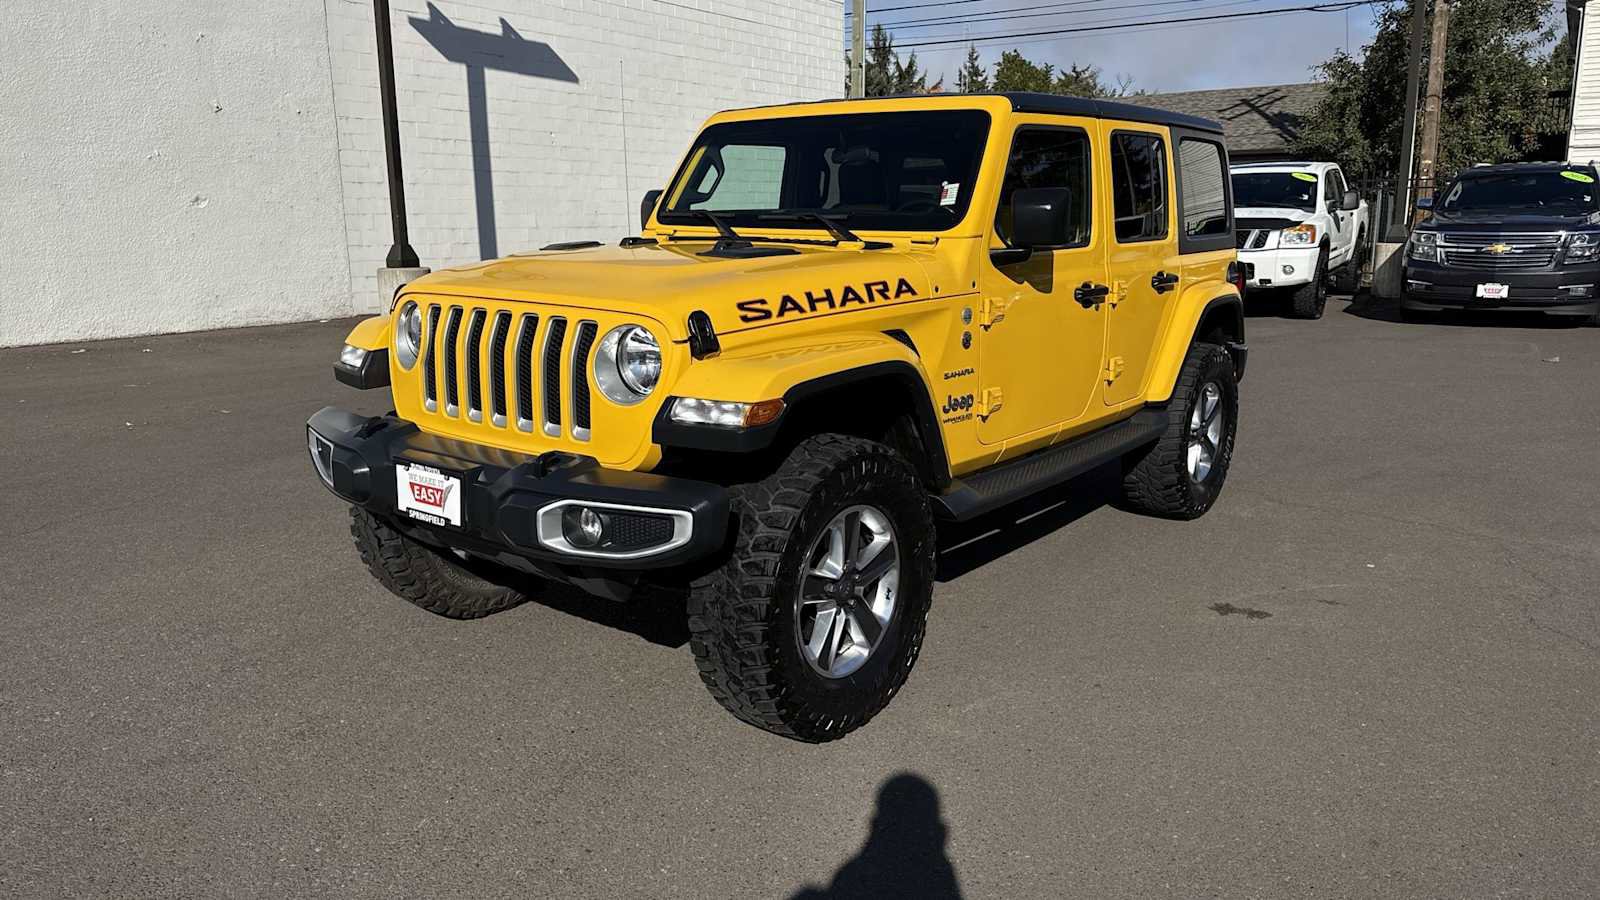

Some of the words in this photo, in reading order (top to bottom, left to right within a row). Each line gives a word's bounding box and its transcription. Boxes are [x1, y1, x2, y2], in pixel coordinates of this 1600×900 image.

[736, 278, 918, 323] SAHARA
[943, 368, 975, 380] SAHARA
[942, 394, 974, 414] Jeep
[413, 485, 442, 505] EASY
[408, 509, 446, 527] SPRINGFIELD
